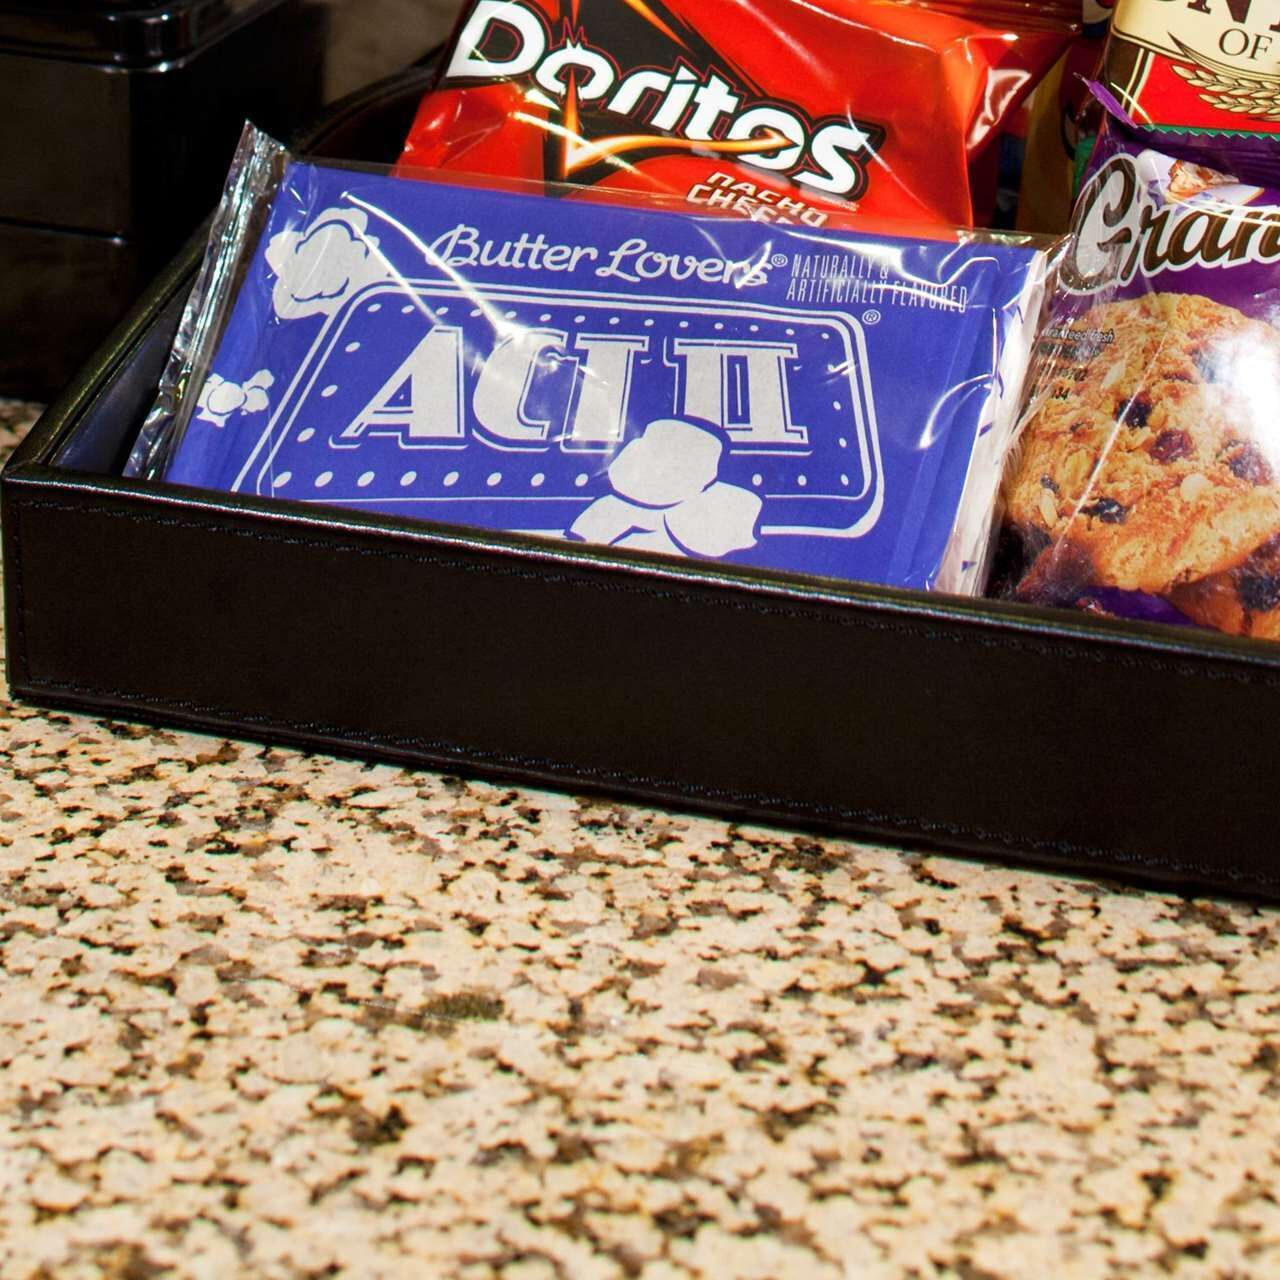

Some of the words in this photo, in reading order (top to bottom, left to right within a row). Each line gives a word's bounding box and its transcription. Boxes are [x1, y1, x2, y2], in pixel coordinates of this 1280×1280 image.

[1217, 27, 1272, 63] OF
[427, 224, 598, 270] Butter
[618, 239, 774, 287] Lovers
[791, 254, 873, 279] NATURALLY
[786, 278, 888, 305] ARTIFICIALLY
[334, 326, 650, 452] ACT
